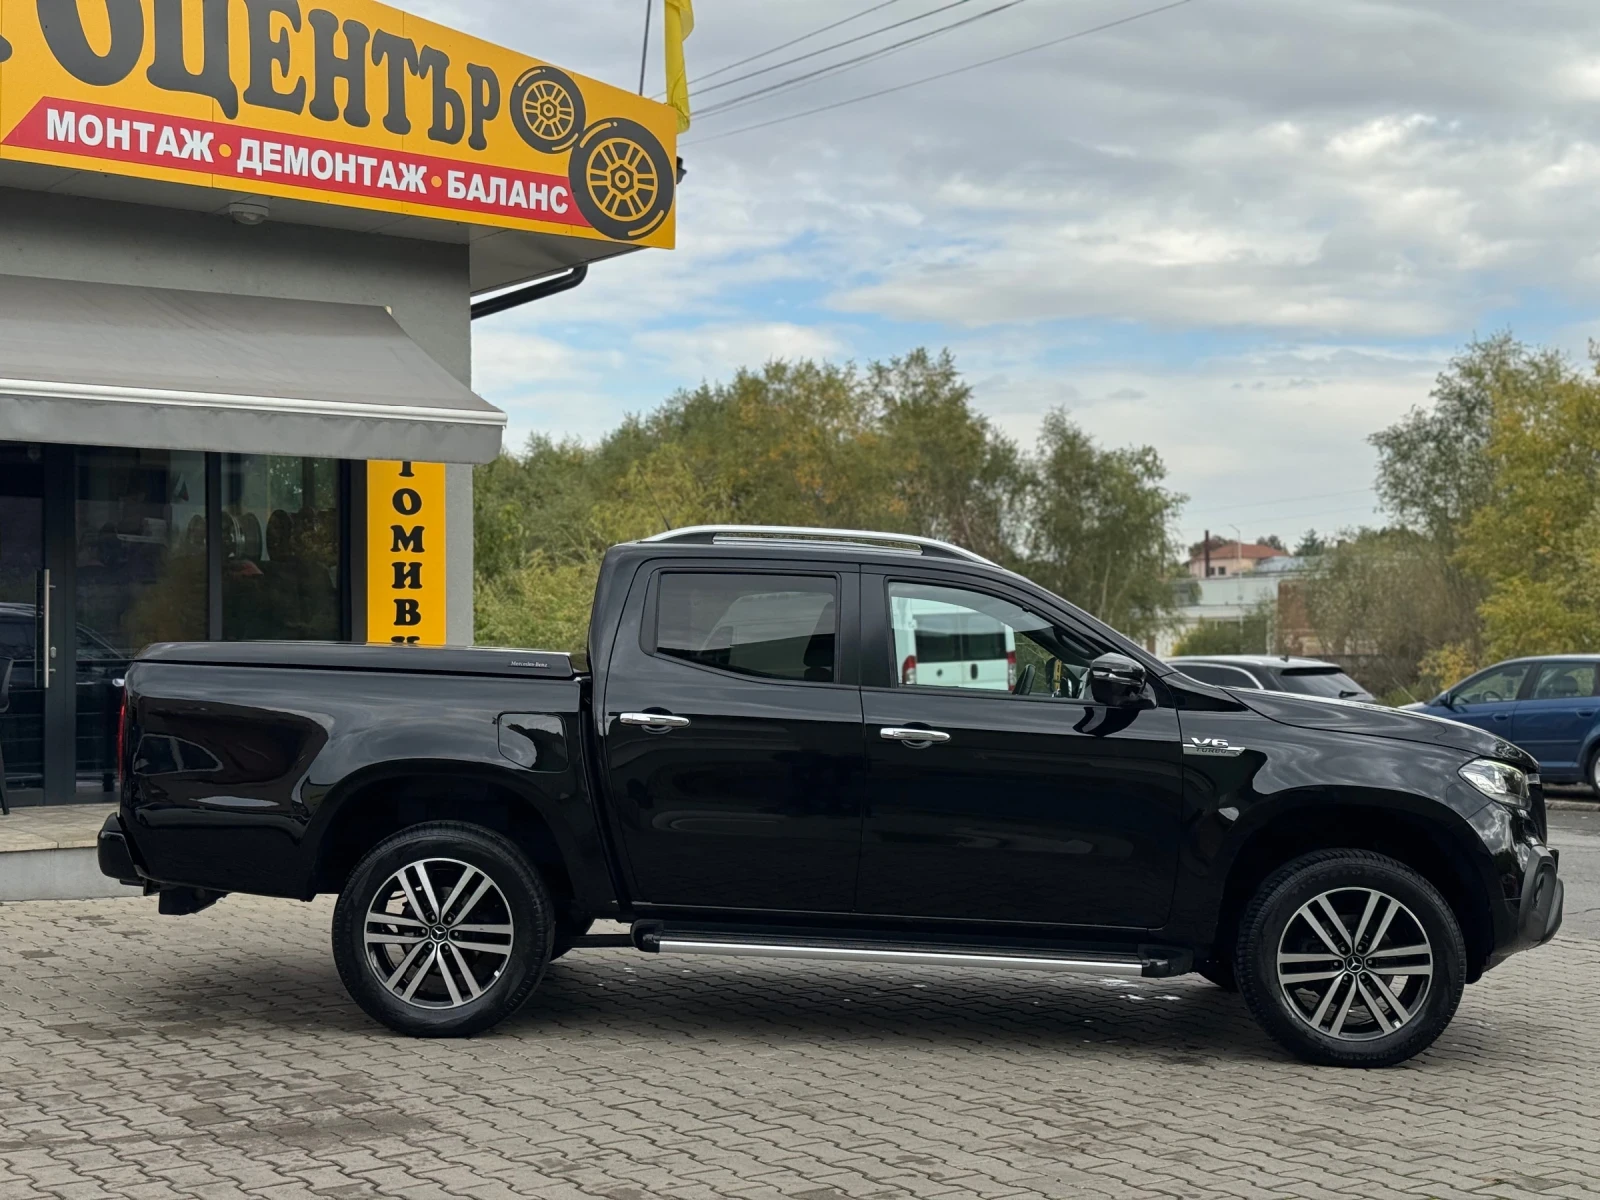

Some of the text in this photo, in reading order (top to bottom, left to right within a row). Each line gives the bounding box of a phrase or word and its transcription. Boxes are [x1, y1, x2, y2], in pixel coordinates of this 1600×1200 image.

[0, 0, 501, 151] ОЦЕНТЪР
[47, 108, 569, 214] МОНТАЖ ДЕМОНТАЖ БАЛАНС
[390, 461, 425, 643] ОМИВ
[1191, 737, 1229, 748] V6
